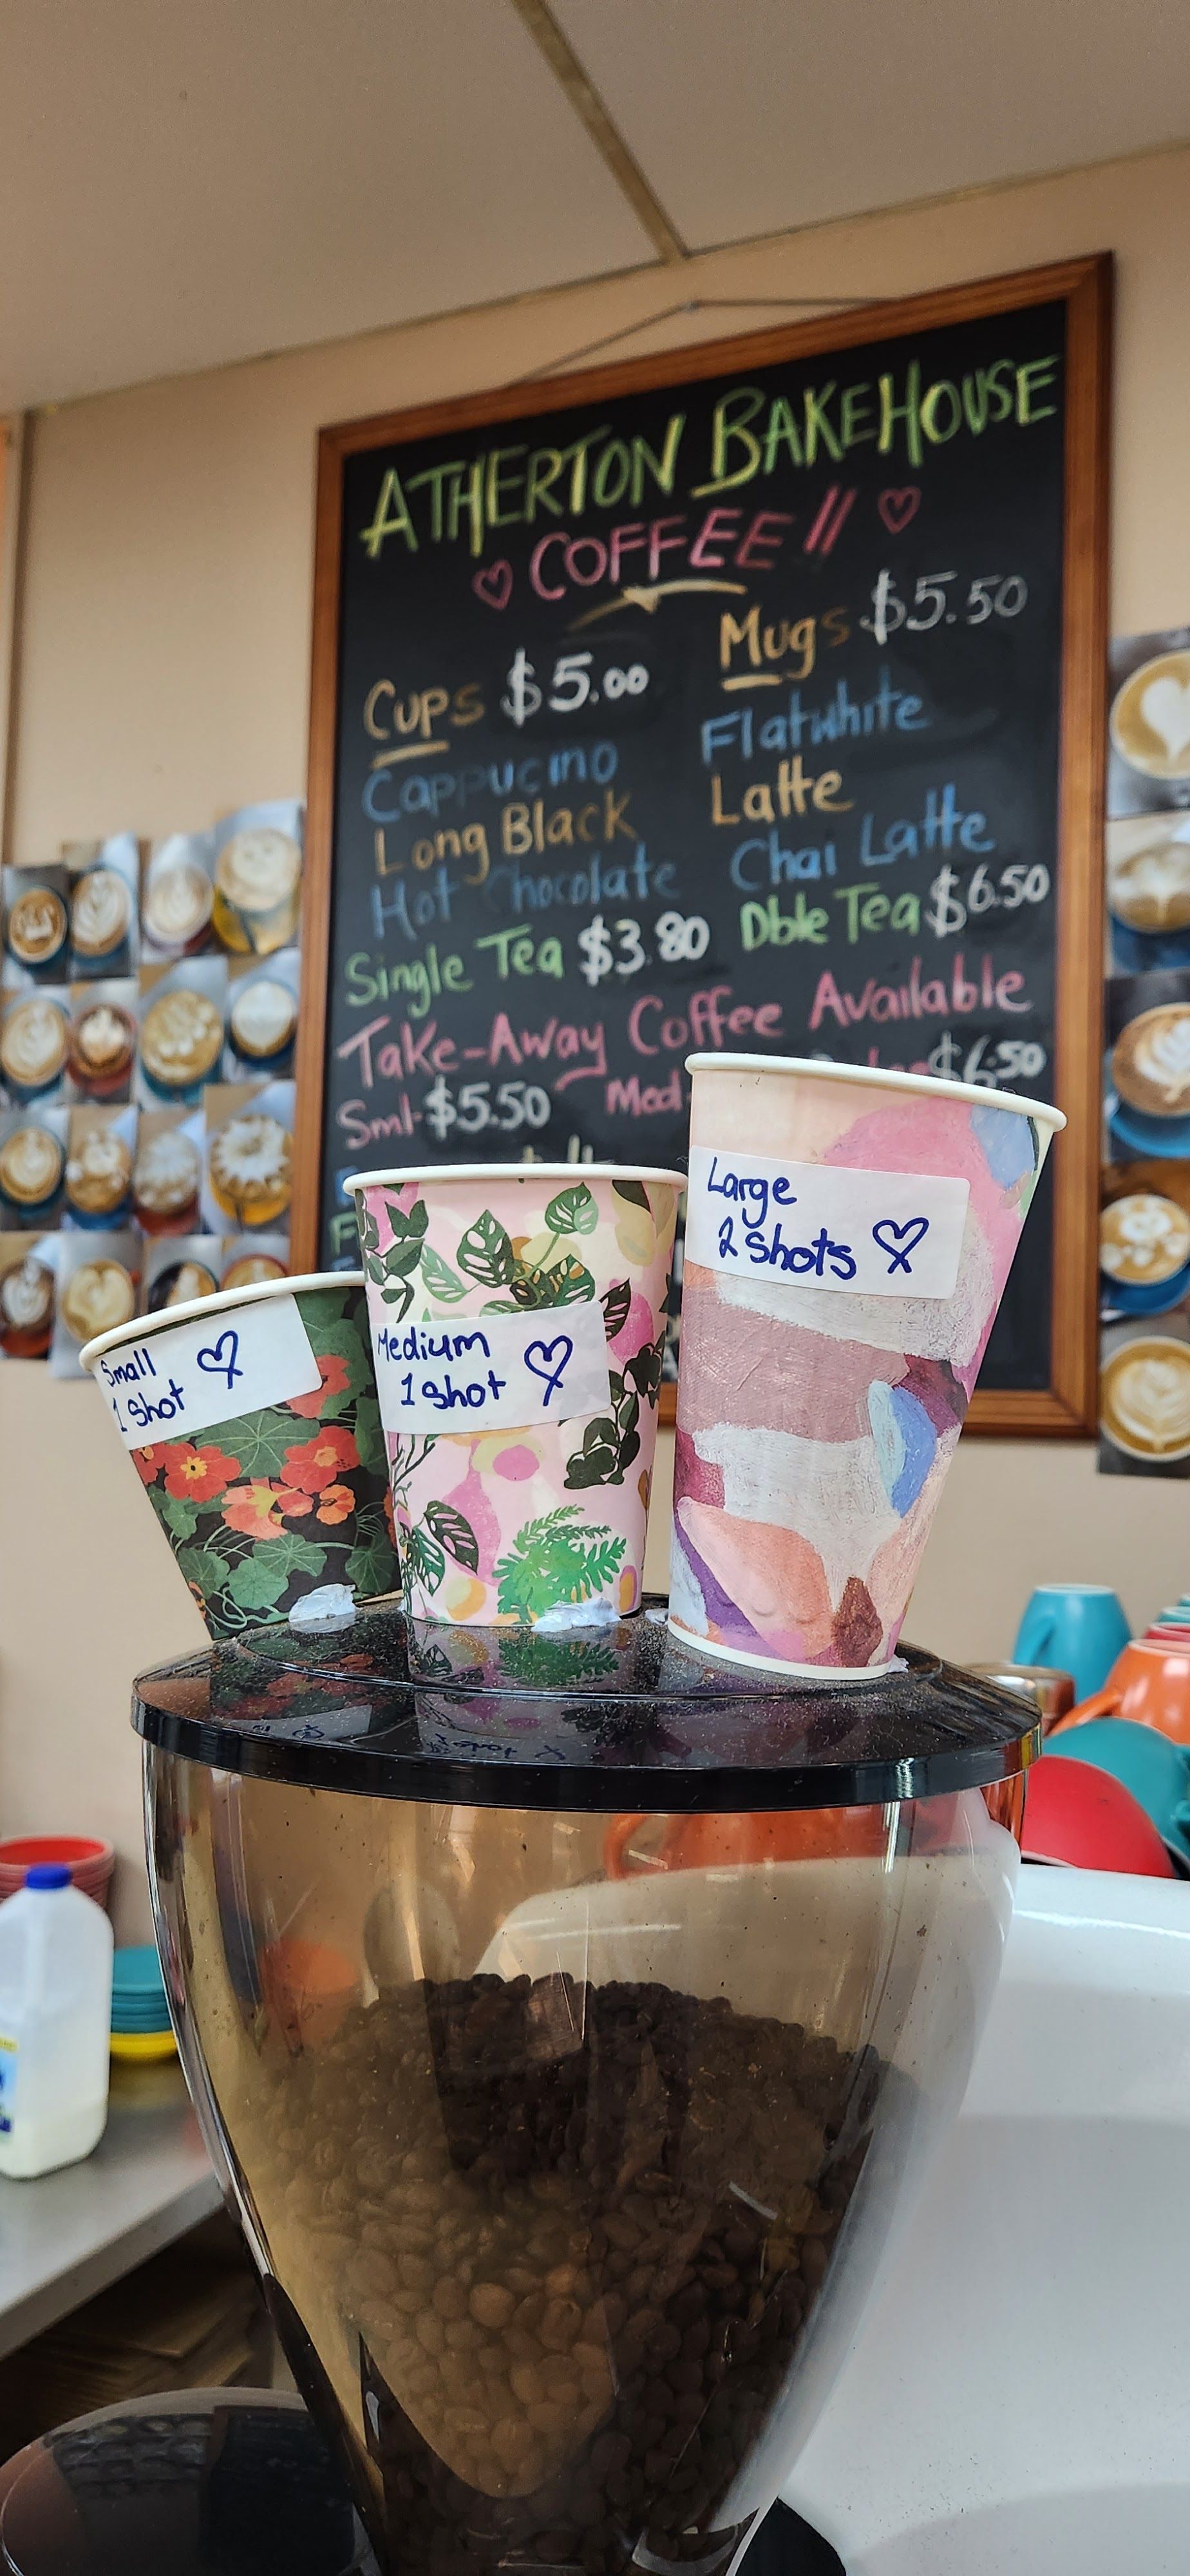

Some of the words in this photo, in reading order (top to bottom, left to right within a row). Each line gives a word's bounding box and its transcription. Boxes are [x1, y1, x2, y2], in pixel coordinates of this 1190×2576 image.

[358, 413, 687, 558] ATHERTON
[690, 354, 1063, 500] BAKEHOUSE
[529, 507, 797, 601] COFFEE
[719, 605, 851, 680] Mugs
[859, 568, 1029, 645] $5.50
[363, 679, 486, 741] Cups
[500, 648, 650, 726] $5.00
[701, 663, 932, 764] Flatwhite
[375, 822, 489, 886] Long
[502, 788, 639, 857] Black
[711, 755, 853, 826] Latte
[730, 830, 836, 893] Chai
[860, 781, 996, 867] Latte
[370, 866, 458, 942] Hot
[484, 839, 681, 914] Chocolate
[739, 891, 830, 952] Dble
[835, 882, 921, 944] Tea
[924, 863, 1050, 940] $6.50
[345, 943, 473, 1018] Single
[475, 923, 565, 980] Tea
[578, 911, 710, 986] $3.80
[628, 984, 786, 1056] Coffee
[808, 952, 1036, 1030] Available
[707, 1157, 798, 1229] Large
[717, 1216, 740, 1258] 2
[100, 1347, 156, 1388] Small
[377, 1327, 491, 1363] Medium
[401, 1372, 415, 1406] 1
[113, 1397, 128, 1433] 1
